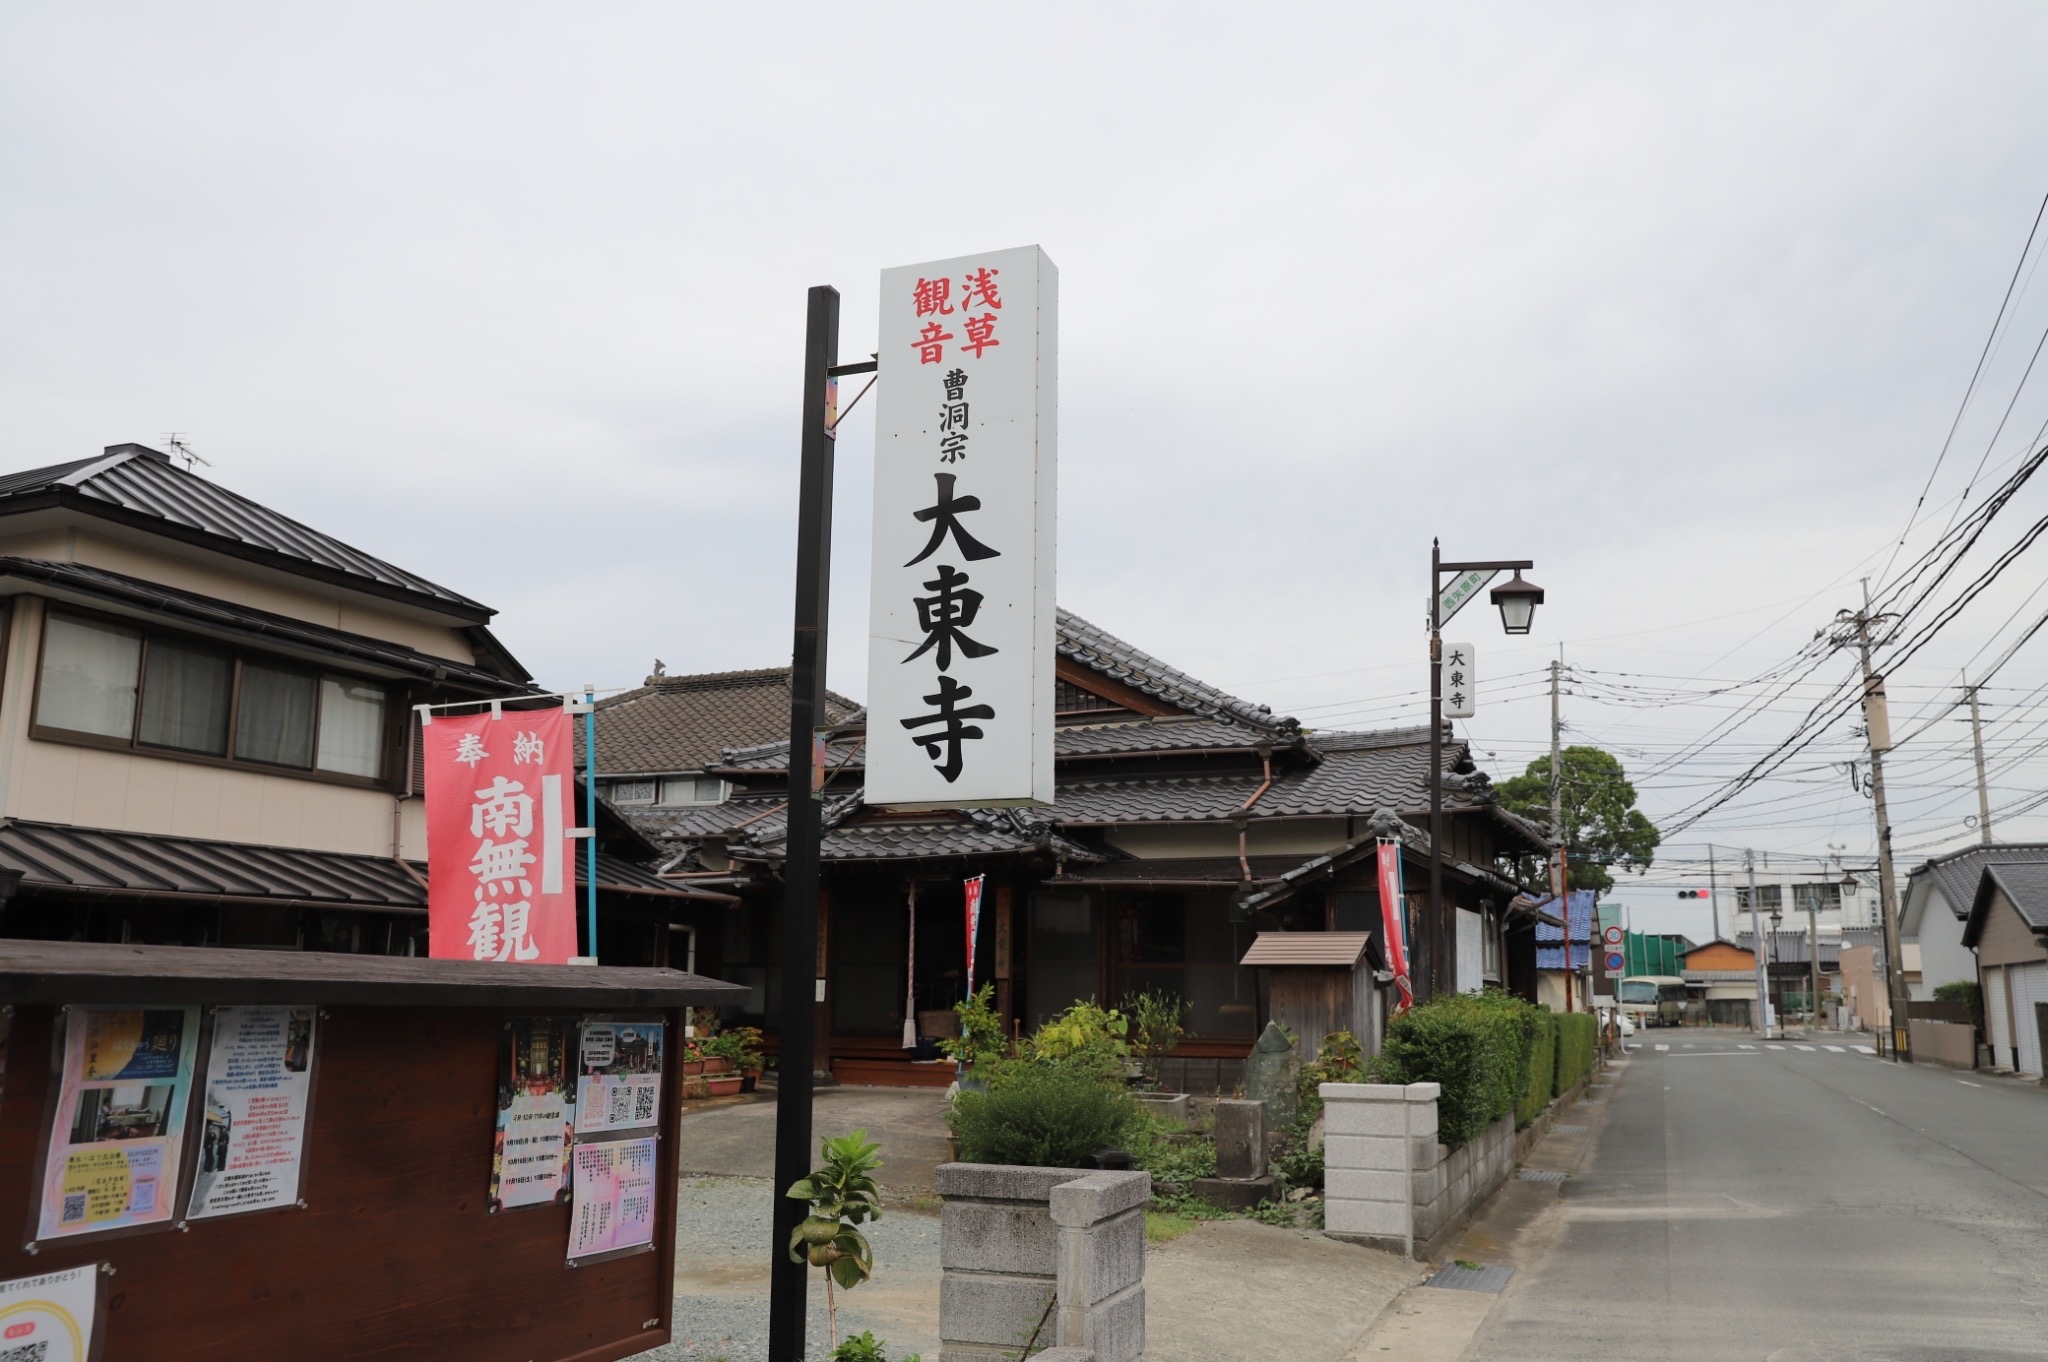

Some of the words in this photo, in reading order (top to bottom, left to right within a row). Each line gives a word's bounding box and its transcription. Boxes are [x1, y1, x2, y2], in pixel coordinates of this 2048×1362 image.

[911, 278, 954, 365] 観音
[961, 267, 1002, 359] 浅草
[939, 368, 969, 464] 曹洞宗
[900, 472, 1001, 783] 大東寺
[1443, 572, 1482, 610] 西矢原町
[1449, 650, 1466, 709] 大東寺
[455, 731, 545, 769] 奉納
[467, 775, 540, 962] 南無観
[1608, 931, 1620, 941] 30
